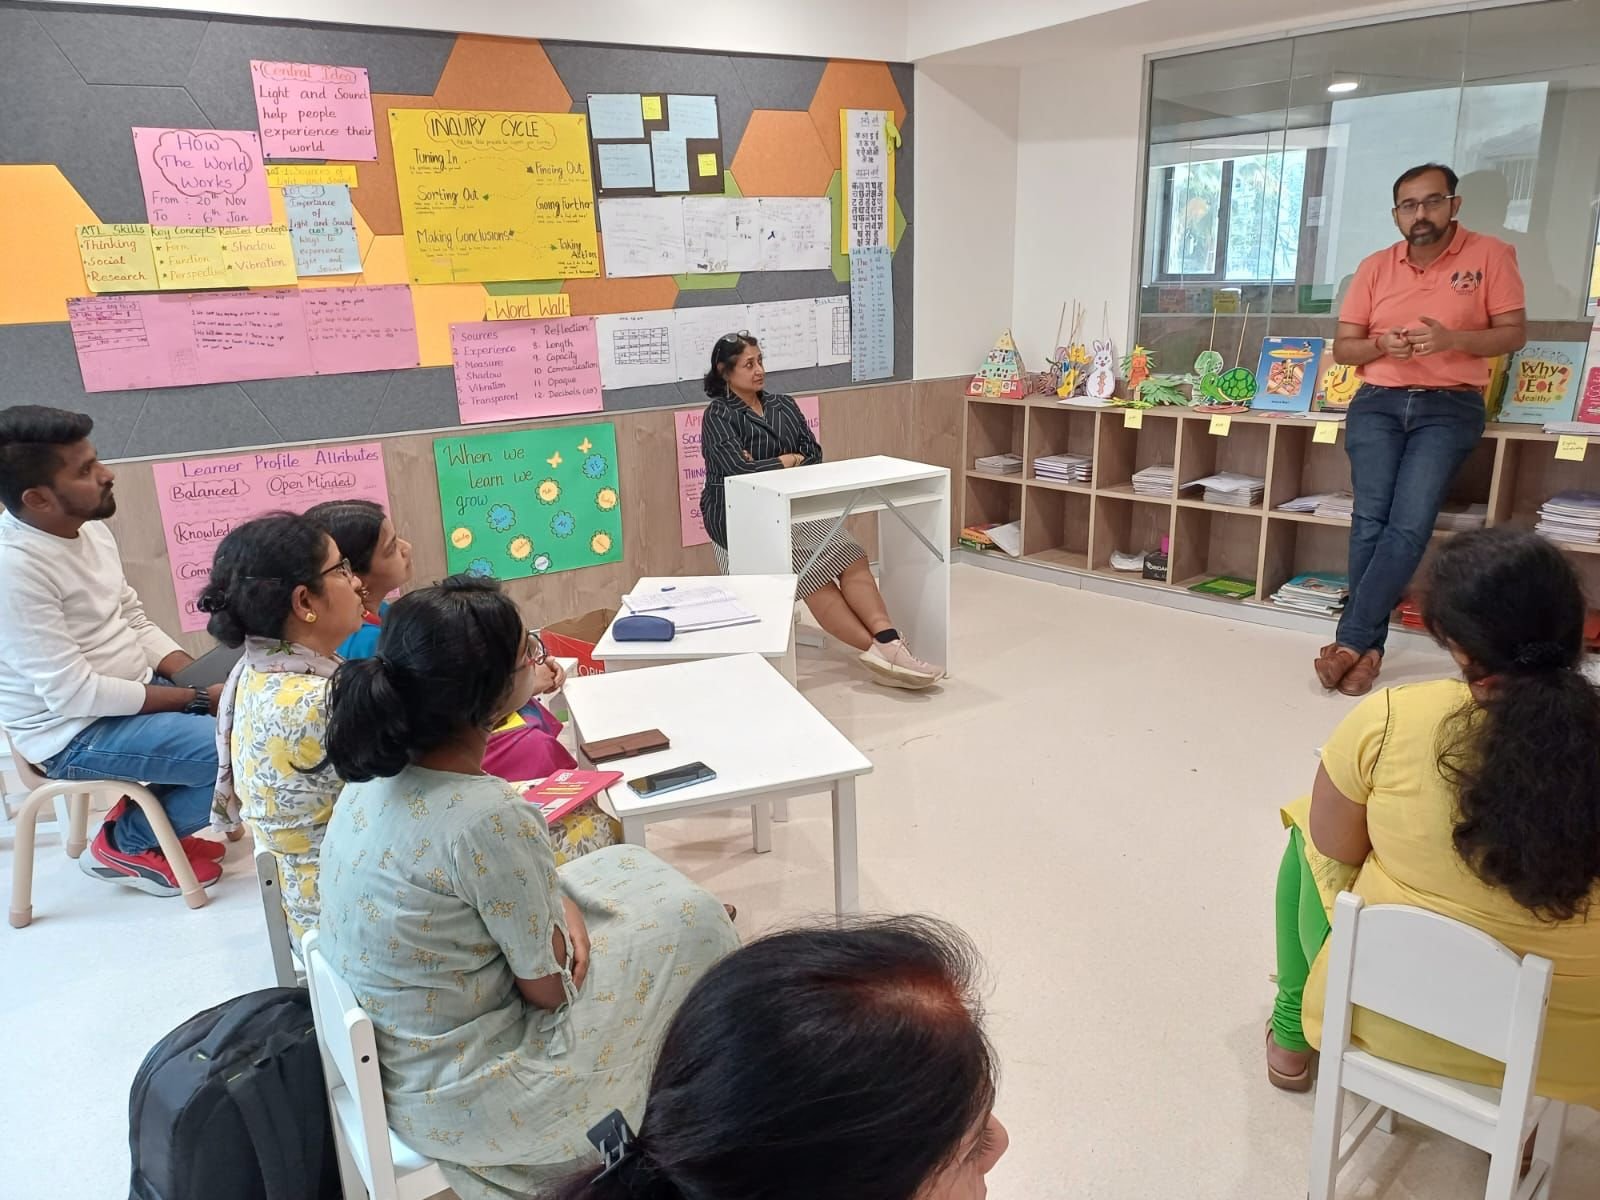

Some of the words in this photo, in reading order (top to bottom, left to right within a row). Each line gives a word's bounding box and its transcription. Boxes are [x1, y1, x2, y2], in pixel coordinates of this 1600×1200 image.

[263, 62, 312, 78] Central
[260, 85, 289, 105] Light
[301, 85, 326, 99] and
[334, 84, 368, 100] Sound
[264, 108, 287, 123] help
[298, 110, 336, 123] people
[264, 126, 338, 144] experience
[348, 125, 374, 137] their
[431, 118, 486, 137] INQUIRY
[501, 119, 540, 137] CYCLE
[178, 133, 219, 151] How
[290, 140, 325, 153] world
[161, 154, 194, 169] The
[205, 154, 250, 171] World
[414, 148, 445, 171] Tuning
[447, 149, 458, 164] In
[566, 161, 585, 175] Out
[181, 175, 232, 189] Works
[152, 190, 179, 205] From
[226, 196, 247, 206] Nov
[416, 184, 459, 206] Sorting
[462, 187, 480, 201] Out
[291, 199, 336, 209] Importance
[535, 196, 560, 217] Going
[153, 210, 168, 221] To
[203, 209, 220, 222] 6th
[227, 213, 249, 223] Jan
[312, 208, 321, 218] of
[313, 217, 328, 227] and
[332, 217, 353, 226] Sound
[81, 225, 102, 235] ATL
[114, 225, 145, 234] Skills
[151, 228, 172, 240] Key
[174, 226, 217, 236] Concepts
[218, 226, 252, 236] Related
[84, 239, 137, 251] Thinking
[417, 228, 452, 248] Making
[558, 238, 582, 252] Taking
[231, 241, 275, 252] Shadow
[299, 247, 345, 256] experience
[87, 255, 126, 266] Social
[168, 255, 210, 265] Function
[571, 250, 598, 259] Action
[235, 257, 287, 271] Vibration
[91, 271, 148, 282] Research
[494, 297, 531, 319] Word
[539, 296, 567, 316] Wall
[461, 331, 499, 342] Sources
[544, 324, 589, 336] Reflection
[463, 345, 516, 358] Experience
[546, 339, 574, 352] Length
[465, 359, 504, 370] Measure
[546, 352, 578, 366] Capacity
[547, 361, 598, 375] Communication
[1520, 362, 1560, 377] Why
[466, 370, 503, 382] Shadow
[547, 376, 577, 388] Opaque
[468, 381, 507, 393] Vibration
[548, 388, 581, 400] Decibels
[470, 392, 519, 406] Transparent
[442, 442, 493, 467] When
[503, 447, 525, 460] we
[181, 461, 243, 478] Learner
[254, 452, 300, 470] Profile
[315, 447, 379, 466] Attributes
[513, 469, 534, 484] we
[173, 481, 239, 500] Balanced
[270, 476, 303, 495] Open
[307, 474, 351, 489] Minded
[455, 495, 489, 516] grow
